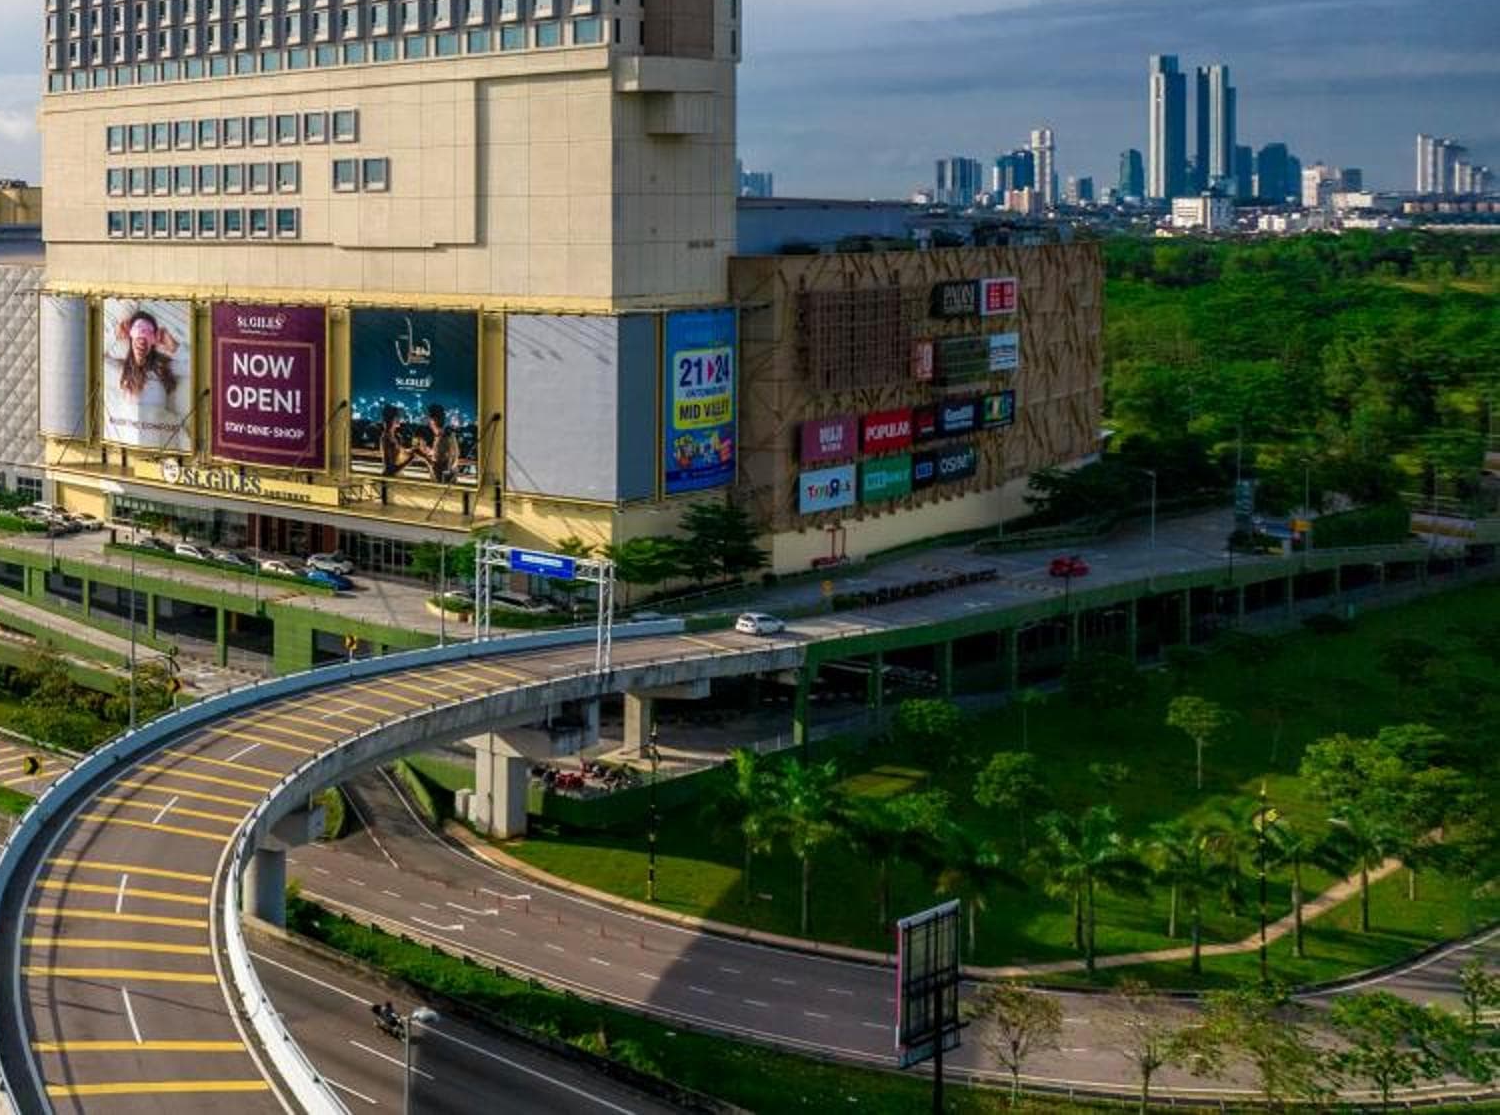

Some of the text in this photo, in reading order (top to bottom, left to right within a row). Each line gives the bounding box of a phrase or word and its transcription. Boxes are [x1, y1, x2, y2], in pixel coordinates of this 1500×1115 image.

[233, 351, 295, 380] NOW
[679, 353, 730, 388] 21 24
[227, 384, 302, 414] OPEN!
[679, 404, 701, 422] MID
[204, 467, 262, 496] GILES
